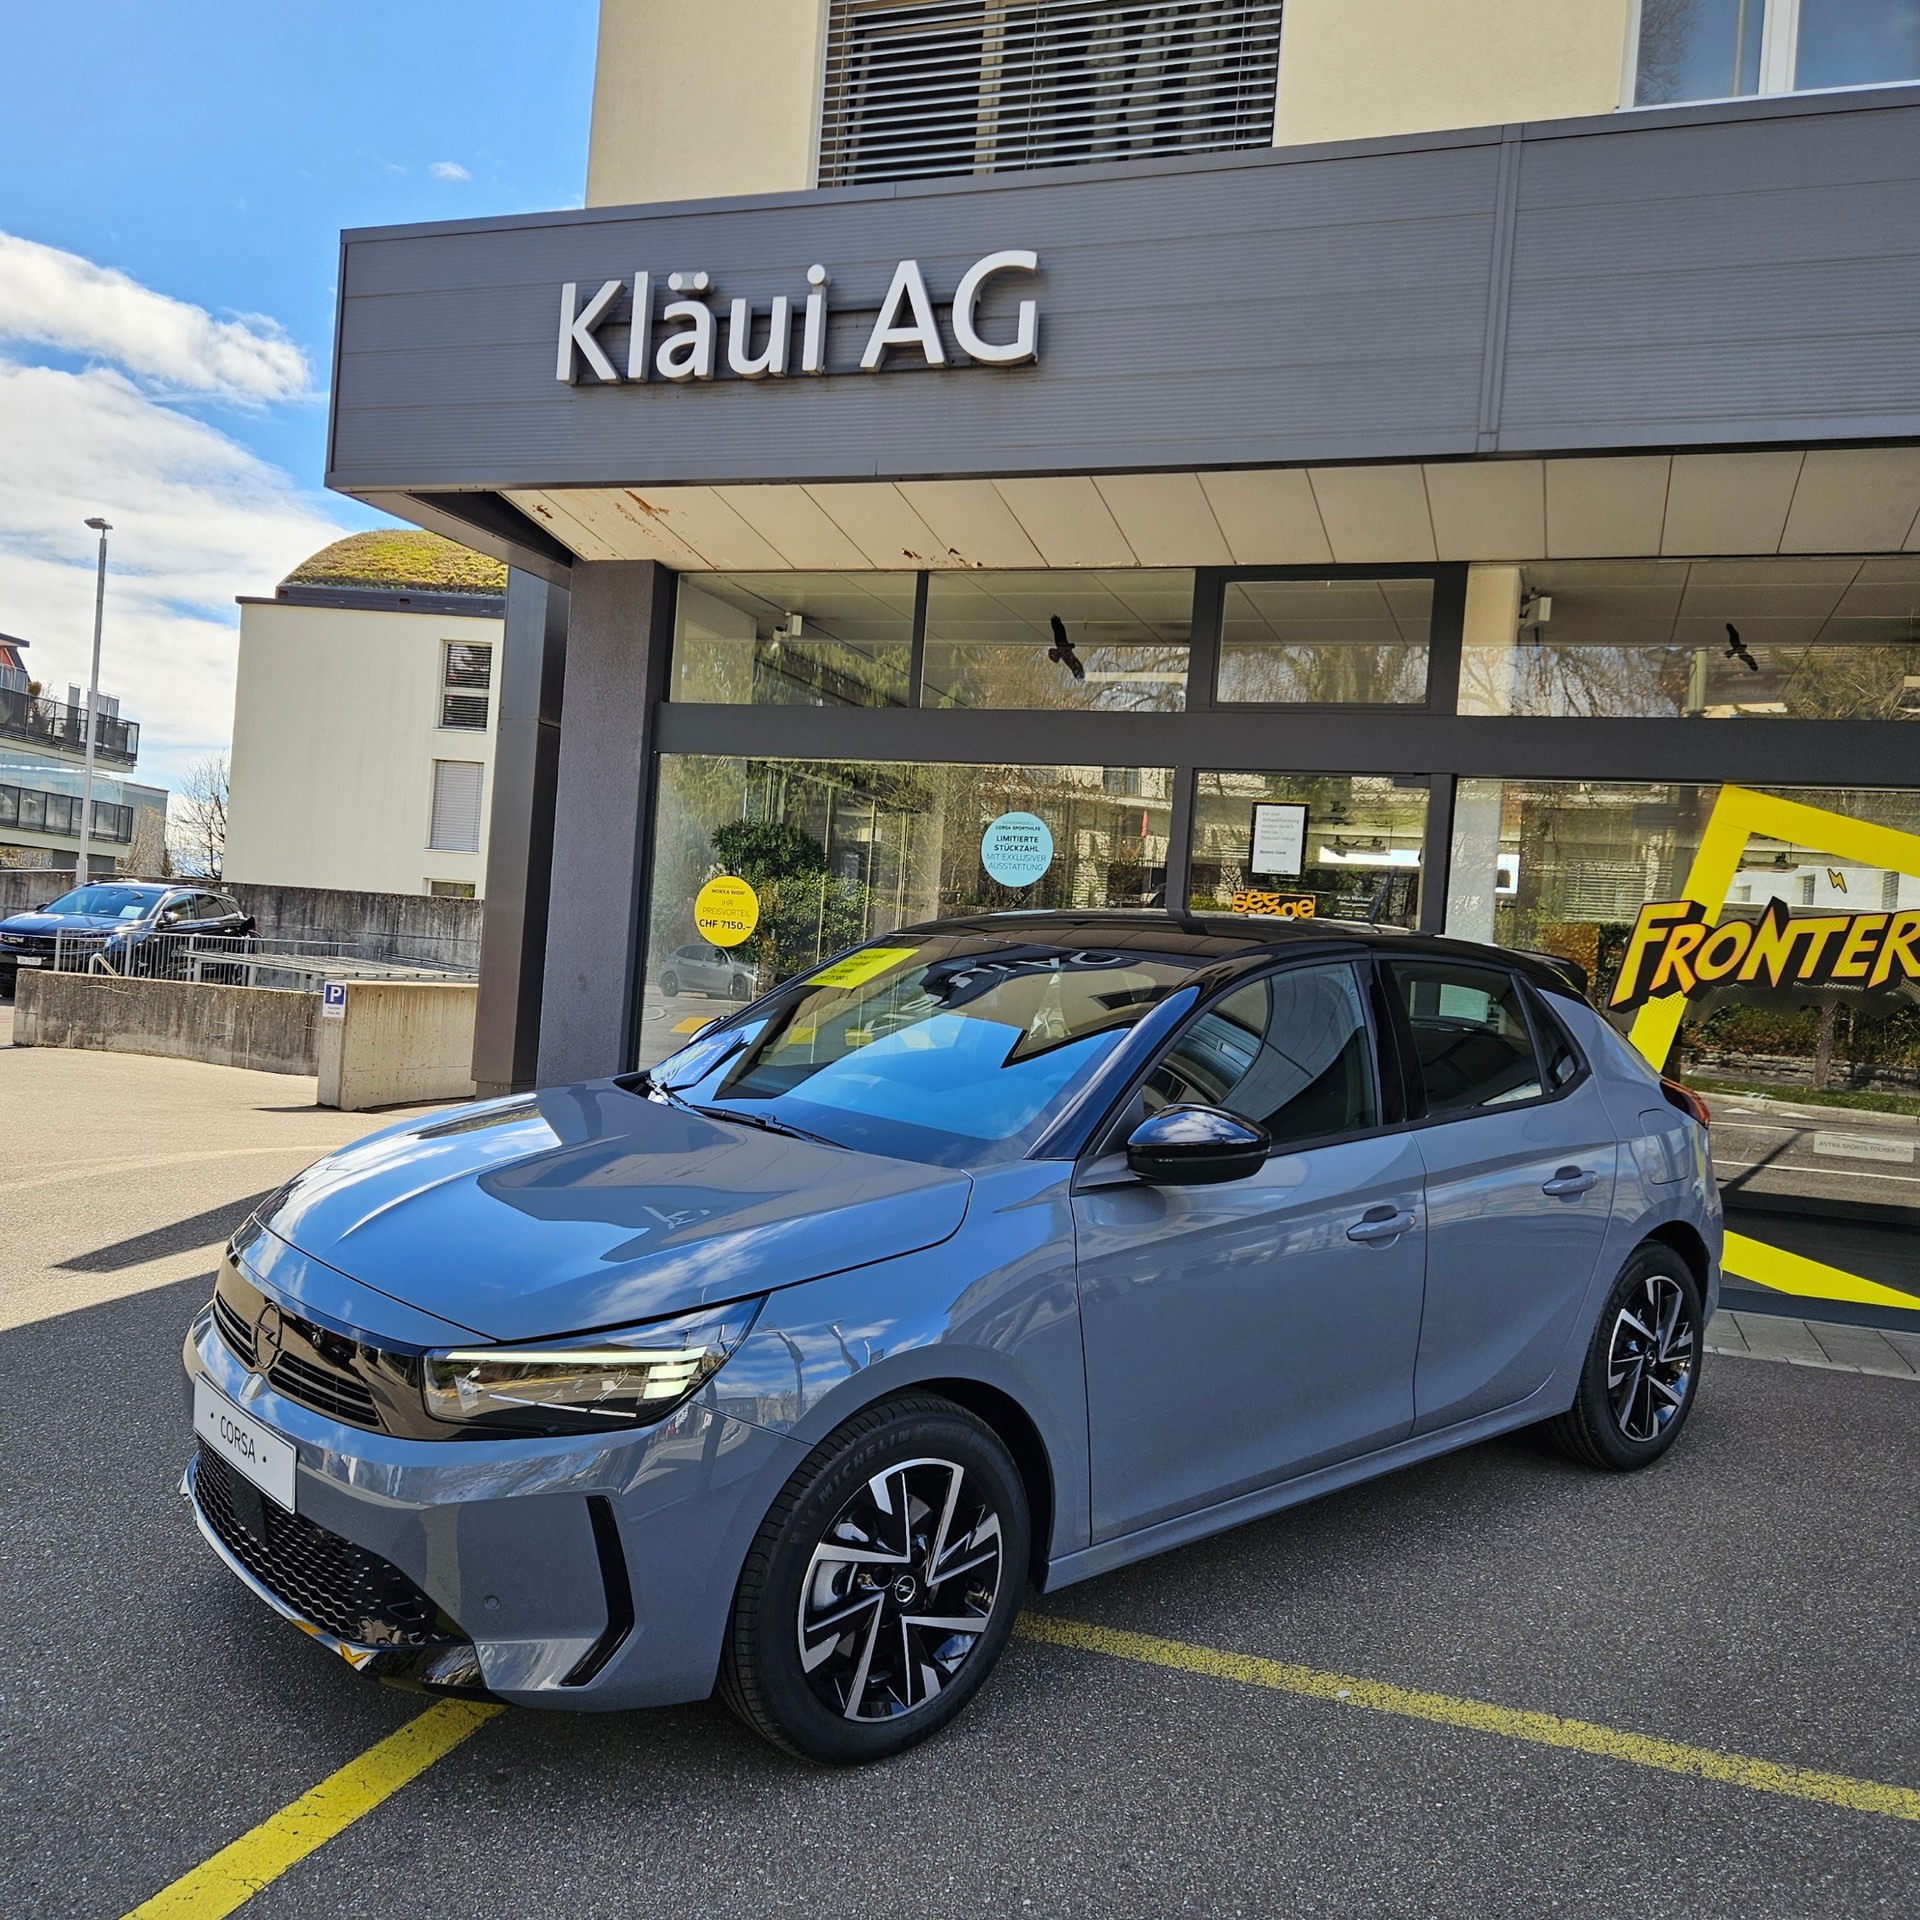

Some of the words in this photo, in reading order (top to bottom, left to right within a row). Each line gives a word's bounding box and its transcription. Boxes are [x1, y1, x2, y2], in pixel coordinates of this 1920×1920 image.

[556, 264, 826, 386] Kläui
[860, 249, 1041, 371] AG
[996, 835, 1039, 844] LIMITIERTE
[994, 842, 1040, 853] STÜCKZAHL
[986, 853, 1001, 861] MIT
[1002, 853, 1047, 863] EXKLUSIVER
[988, 862, 1044, 872] AUSSTATTUNG
[721, 899, 734, 907] IHR
[702, 906, 751, 918] PREISVORTEIL
[699, 918, 718, 928] CHF
[330, 986, 342, 1002] P
[1819, 1141, 1840, 1149] ASTRA
[1842, 1143, 1868, 1152] SPORTS
[220, 1415, 256, 1464] CORSA
[817, 1428, 911, 1501] MICHELIN
